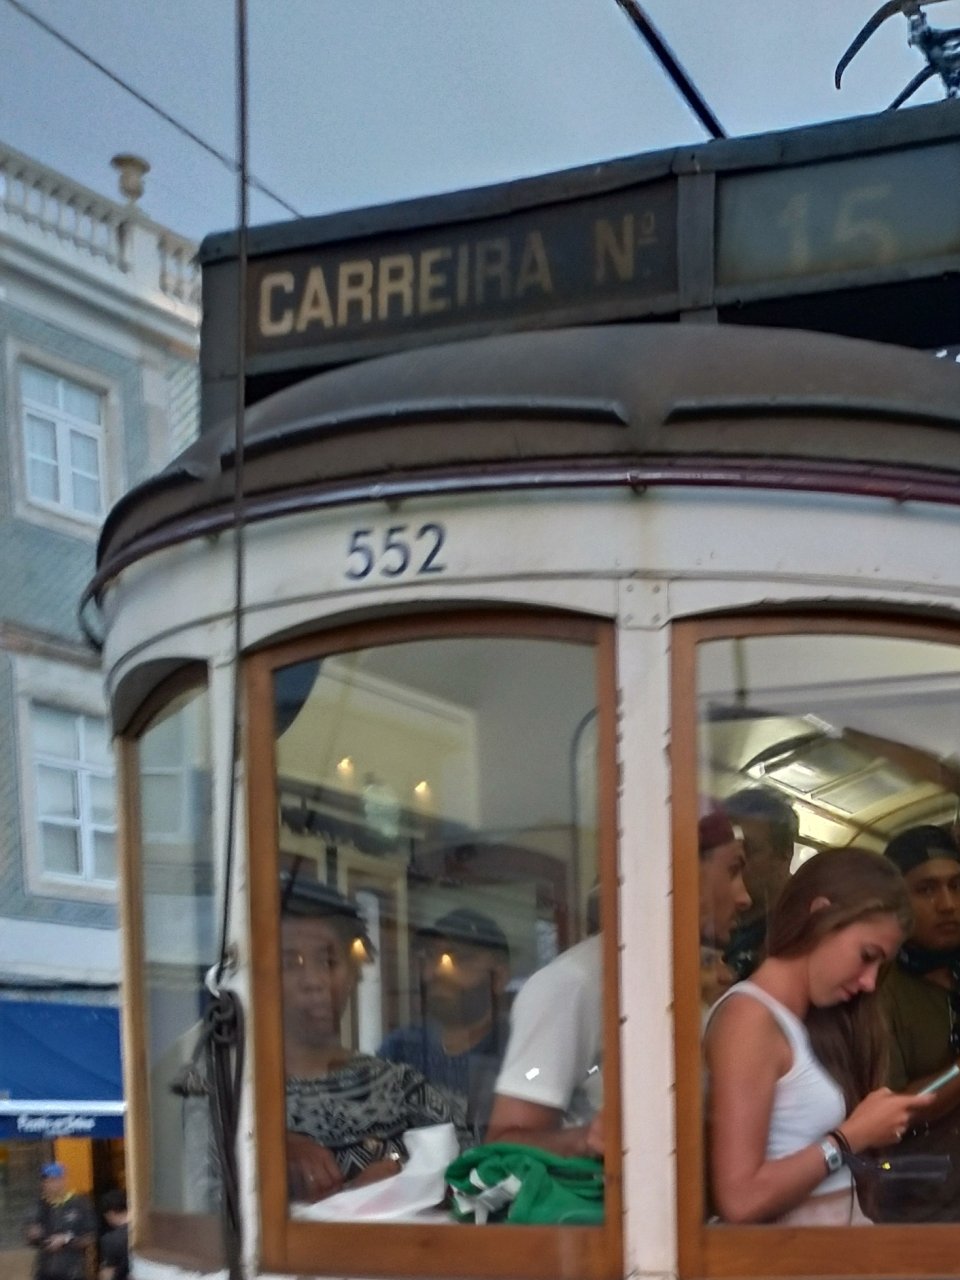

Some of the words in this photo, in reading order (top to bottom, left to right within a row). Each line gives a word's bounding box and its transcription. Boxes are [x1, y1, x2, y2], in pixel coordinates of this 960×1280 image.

[259, 229, 554, 338] CARREIRA
[777, 184, 898, 275] 15
[344, 523, 447, 580] 552
